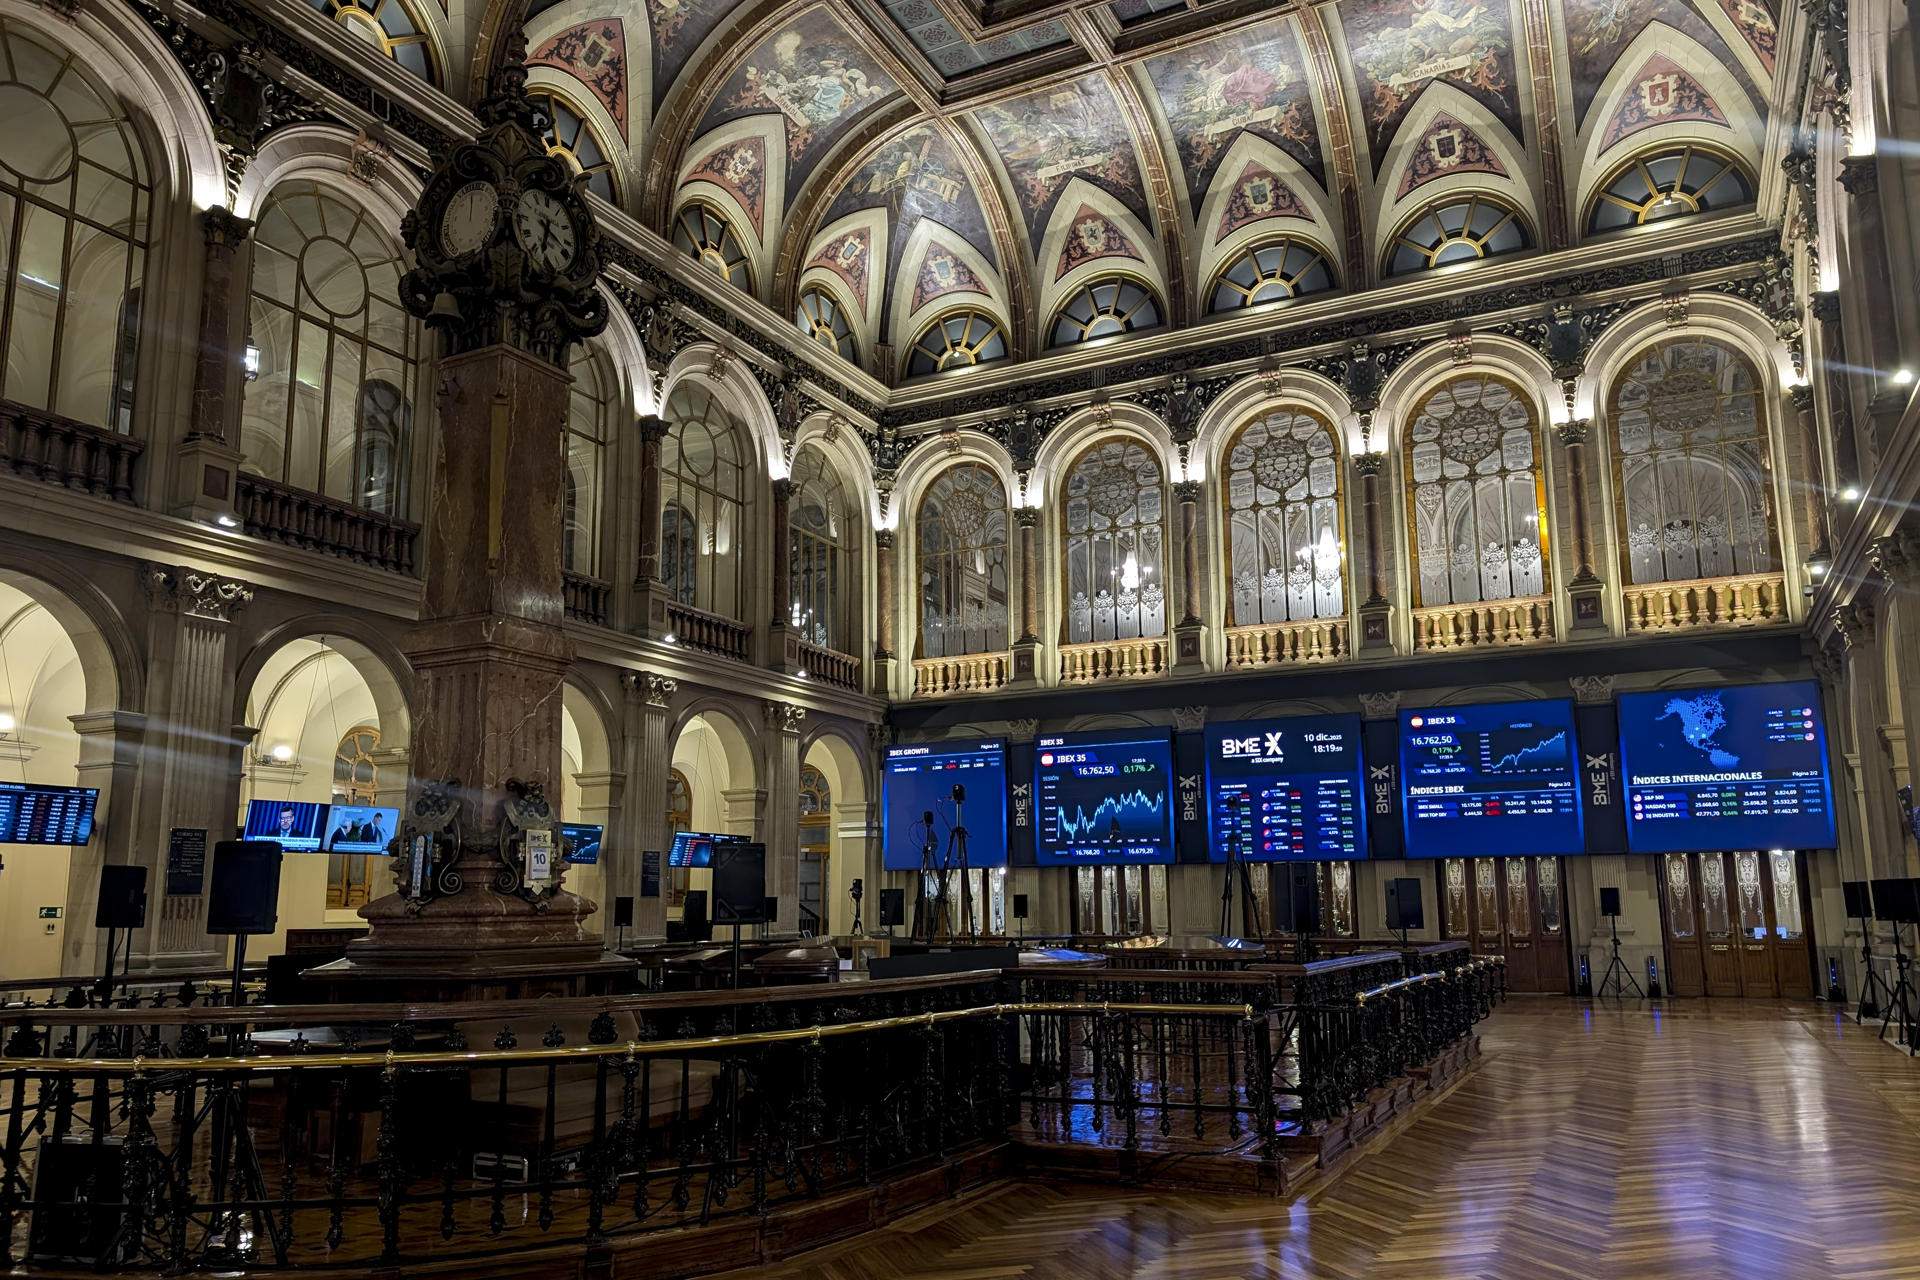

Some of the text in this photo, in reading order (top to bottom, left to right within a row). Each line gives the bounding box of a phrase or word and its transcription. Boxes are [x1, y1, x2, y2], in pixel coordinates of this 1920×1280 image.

[1222, 737, 1260, 755] BME
[1412, 736, 1453, 746] 16.762,50
[1057, 754, 1086, 763] IBEX 35
[1078, 766, 1114, 775] 16.762,50
[1123, 765, 1146, 773] 0,17%
[1632, 772, 1763, 785] ÍNDICES INTERNACIONALES
[1410, 785, 1464, 795] ÍNDICES IBEX
[1591, 772, 1607, 805] BME
[1375, 783, 1388, 813] BME
[1183, 791, 1194, 821] BME
[1015, 799, 1026, 826] BME
[533, 853, 546, 864] 10
